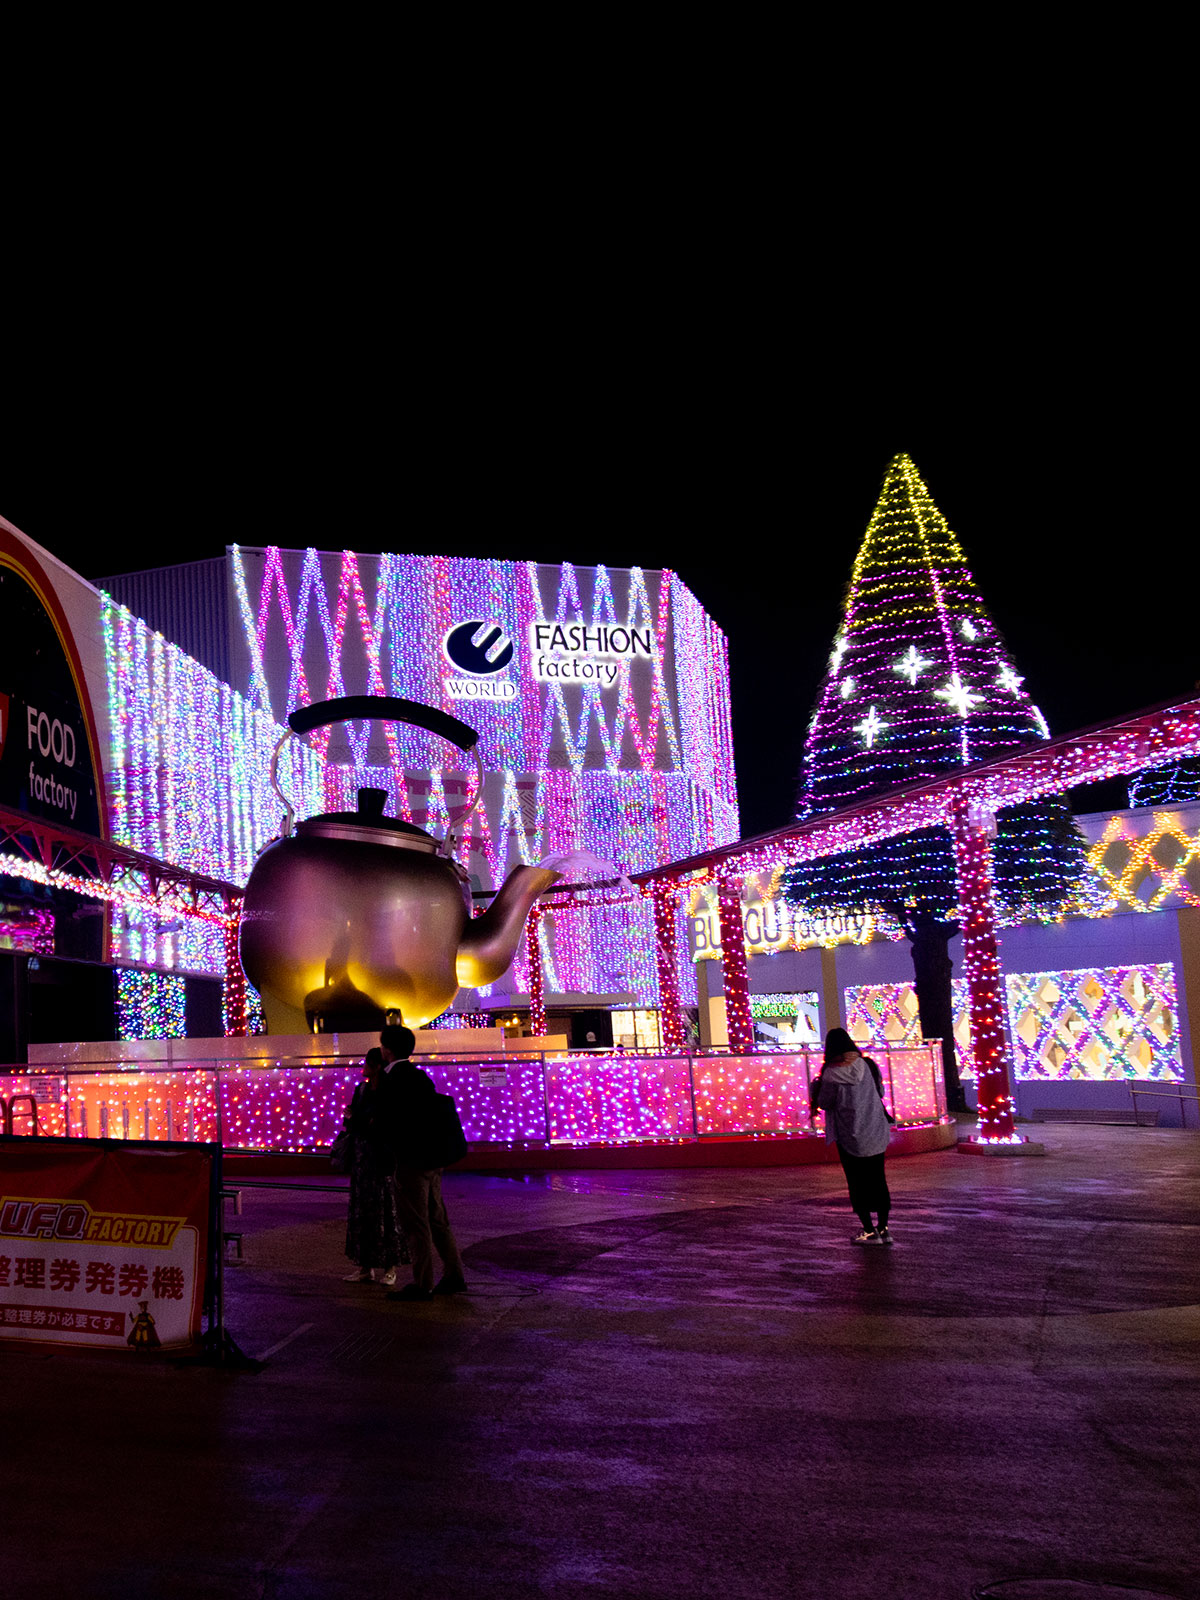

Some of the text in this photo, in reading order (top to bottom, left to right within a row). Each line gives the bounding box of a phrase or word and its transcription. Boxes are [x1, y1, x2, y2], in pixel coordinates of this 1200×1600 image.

[535, 624, 652, 654] FASHION
[538, 656, 618, 684] factory
[449, 681, 516, 697] WORLD
[26, 705, 76, 768] FOOD
[29, 760, 78, 821] factory
[691, 902, 781, 950] BUGU
[86, 1217, 176, 1246] FACTORY
